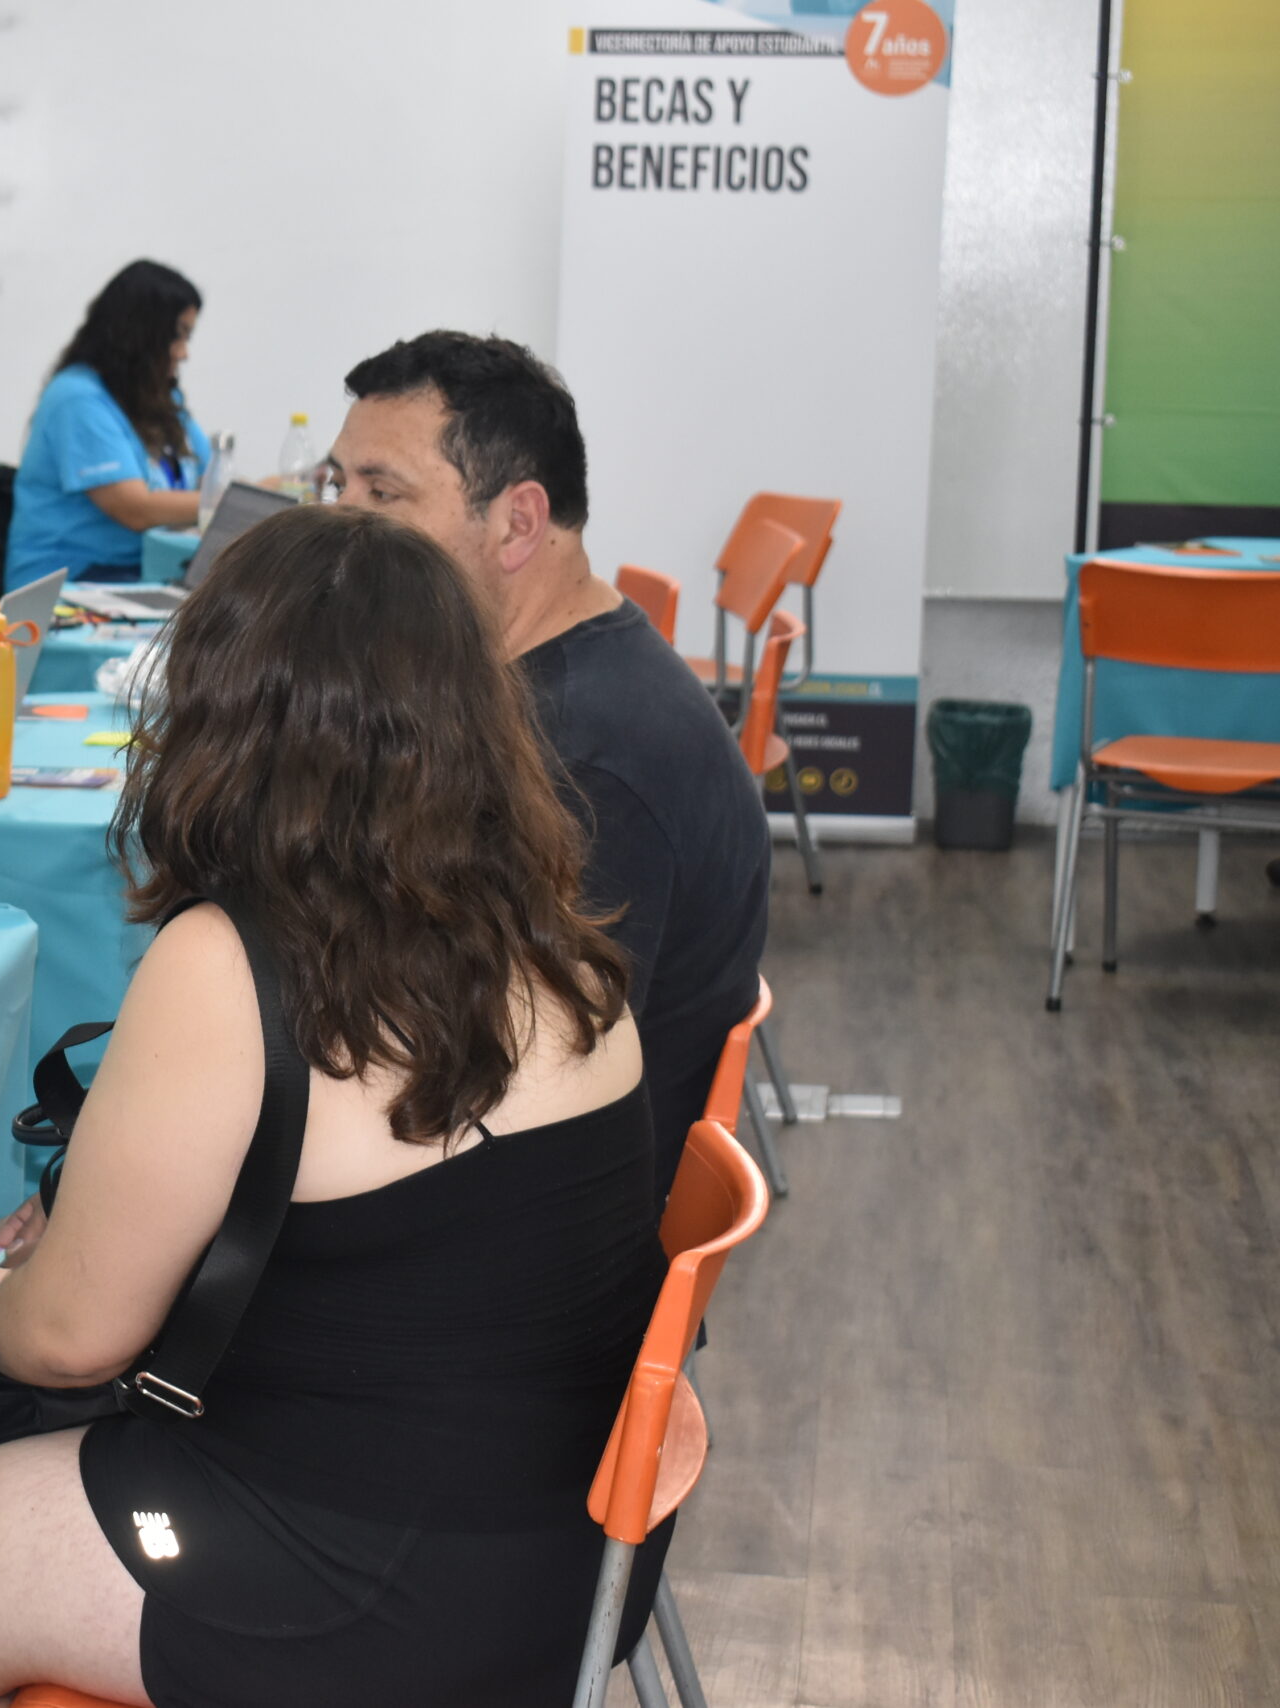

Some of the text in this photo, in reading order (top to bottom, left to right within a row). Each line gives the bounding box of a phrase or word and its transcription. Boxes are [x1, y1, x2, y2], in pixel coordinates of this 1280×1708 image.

[694, 32, 713, 54] DE
[861, 11, 888, 56] 7
[594, 76, 751, 126] BECAS Y
[591, 142, 810, 194] BENEFICIOS
